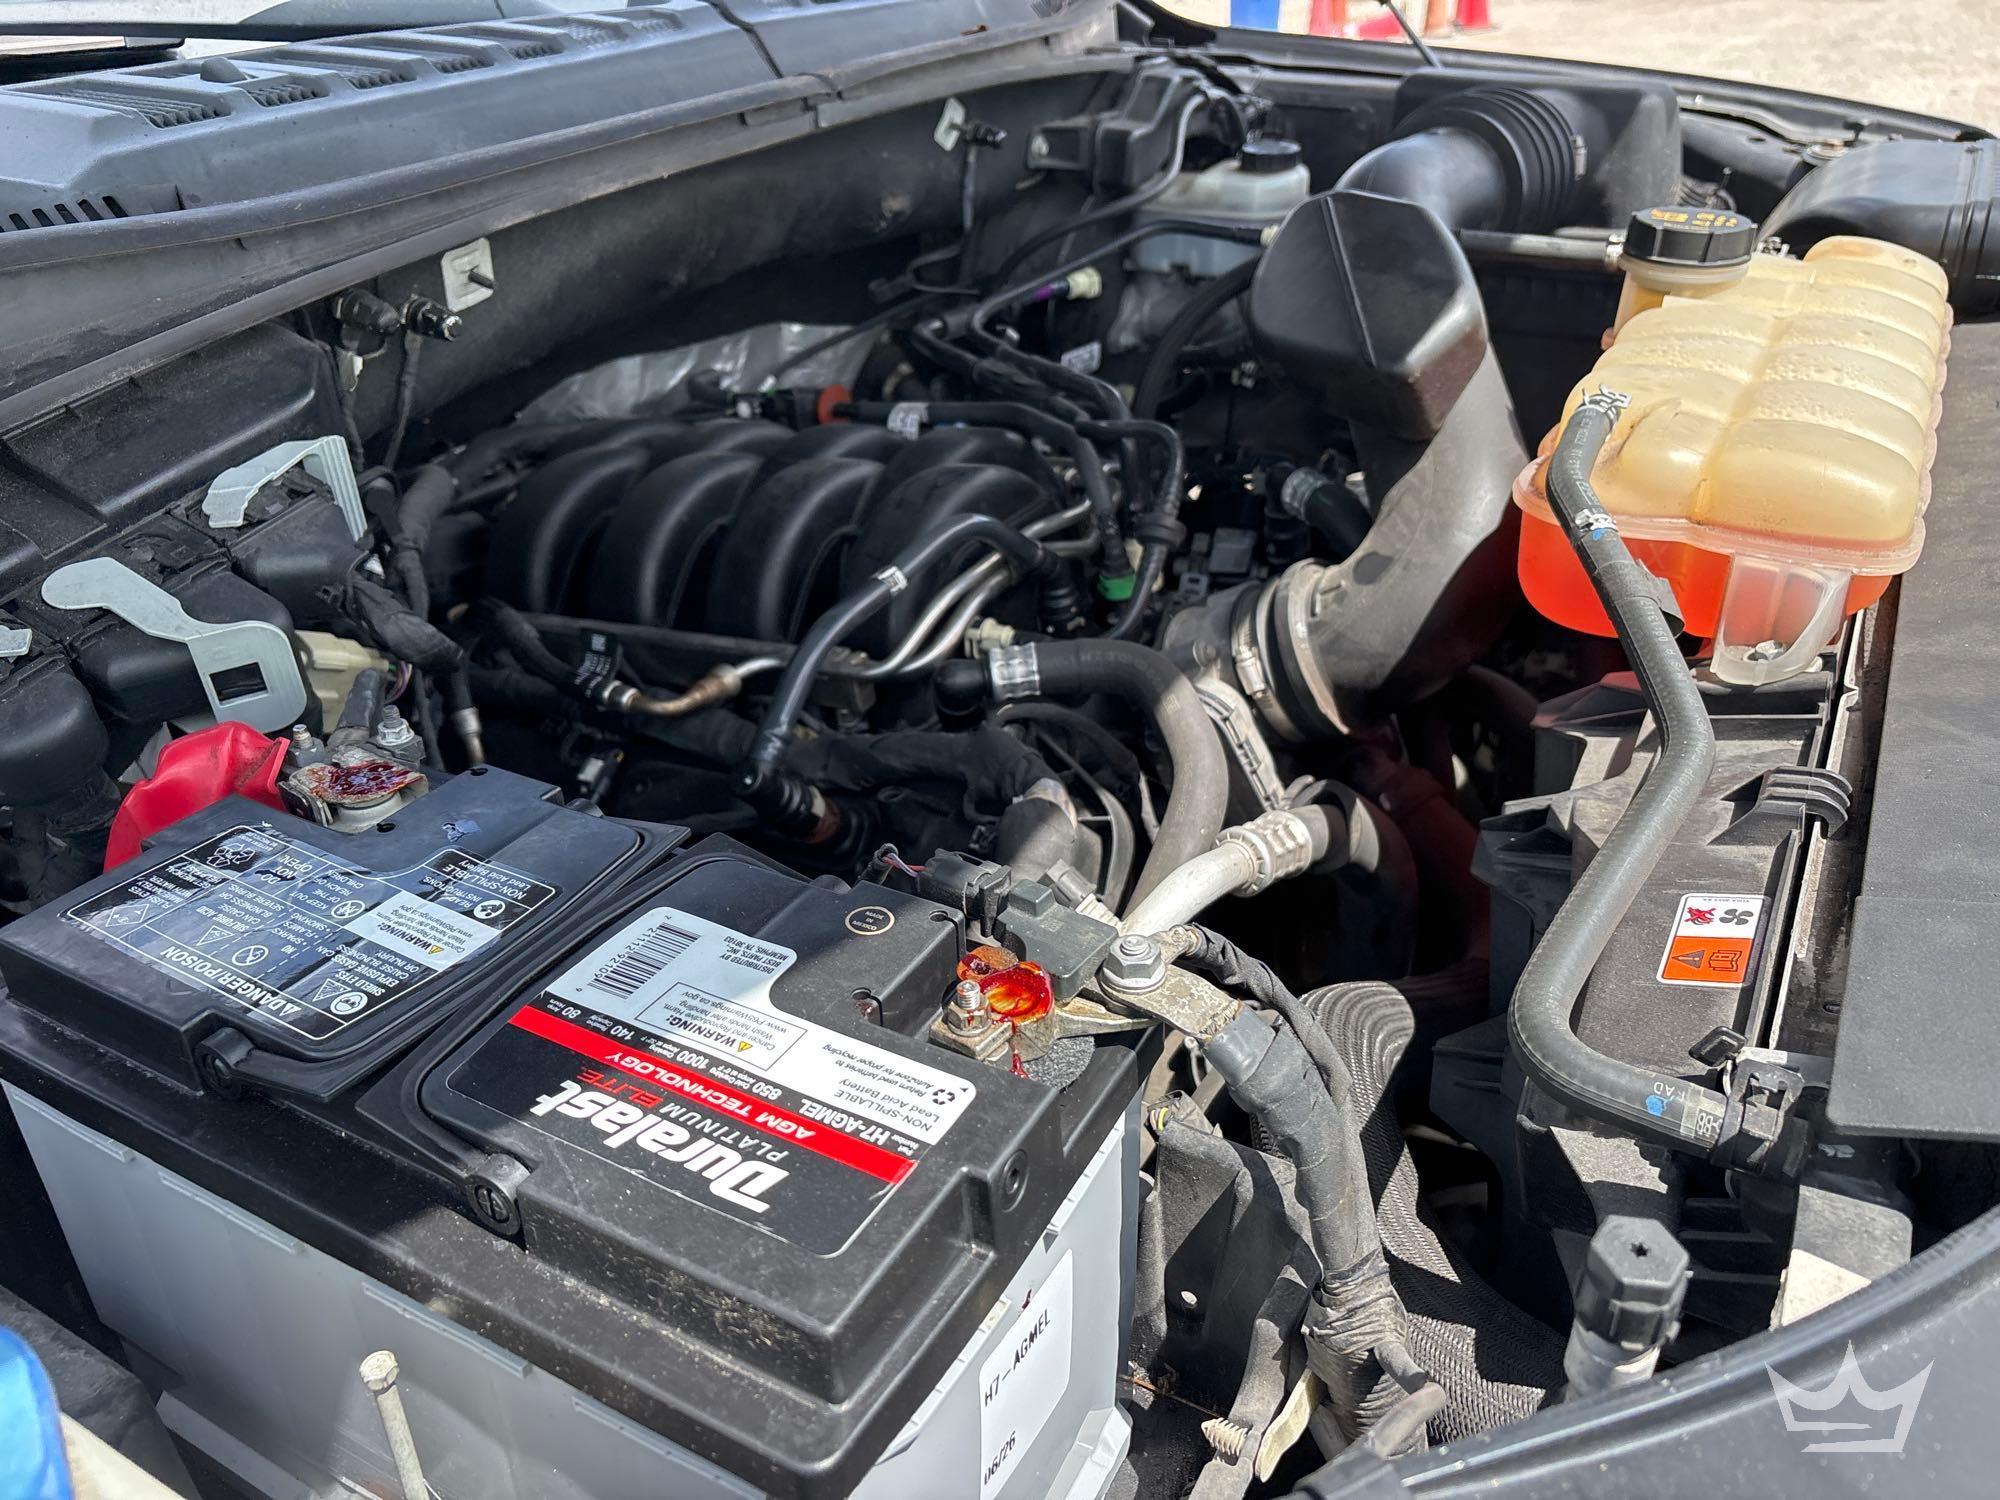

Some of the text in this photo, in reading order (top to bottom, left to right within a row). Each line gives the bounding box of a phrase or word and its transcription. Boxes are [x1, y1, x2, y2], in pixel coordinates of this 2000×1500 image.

[270, 865, 298, 878] NOT
[277, 854, 312, 872] OPEN.
[260, 873, 280, 884] DO
[443, 864, 525, 898] NON-SPILLABLE
[458, 859, 530, 890] Lead Acid Battery
[128, 886, 172, 908] FLUSH EYES
[312, 888, 340, 903] OF THE
[324, 882, 352, 896] REACH
[423, 875, 481, 901] INSTRUCTIONS.
[218, 891, 272, 917] BLINDNESS OR
[252, 895, 284, 911] SEVERE
[289, 890, 328, 909] KEEP OUT
[447, 896, 472, 907] READ
[195, 905, 248, 931] SULFURIC ACID
[217, 903, 260, 924] CAN CAUSE
[290, 912, 327, 930] SMOKING
[283, 921, 315, 937] FLAMES
[851, 920, 878, 931] MEXICO
[271, 927, 303, 944] SPARKS
[378, 922, 431, 949] WARNING:
[428, 934, 443, 942] and
[625, 927, 657, 950] 21112
[723, 936, 745, 947] 38103
[280, 944, 296, 954] NO
[441, 941, 465, 953] Cancer
[315, 945, 398, 986] EXPLOSIVE GASES CAN
[336, 944, 408, 979] CAUSE BLINDNESS
[374, 949, 419, 972] OR INJURY.
[594, 953, 625, 978] 92109
[730, 956, 774, 974] DISTRIBUTED
[761, 957, 781, 967] BEST
[160, 946, 285, 1009] DANGER/POISON
[354, 979, 385, 995] SHIELD
[549, 998, 565, 1008] Hours
[561, 1006, 581, 1018] 80
[663, 1003, 775, 1050] Cancer and Reproductive Harm.
[679, 1000, 772, 1040] Wash hands after handling.
[610, 1025, 634, 1039] 140
[666, 1014, 735, 1046] WARNING:
[649, 1043, 674, 1058] Cranking
[662, 1043, 680, 1052] Amps
[676, 1050, 708, 1068] 1000
[822, 1044, 933, 1088] AutoZone for proper recycling
[709, 1067, 749, 1089] Cold Cranking
[737, 1073, 755, 1083] Amps
[844, 1063, 878, 1079] batteries
[877, 1076, 898, 1085] used
[607, 1053, 814, 1138] AGM TECHNOLOGY
[752, 1081, 781, 1099] 850
[898, 1083, 926, 1097] Return
[839, 1078, 939, 1122] Lead Acid Battery
[834, 1089, 931, 1131] NON-SPILLABLE
[799, 1099, 889, 1144] H7-AGMEL
[660, 1103, 787, 1161] PLATINUM
[529, 1079, 790, 1214] Duralast
